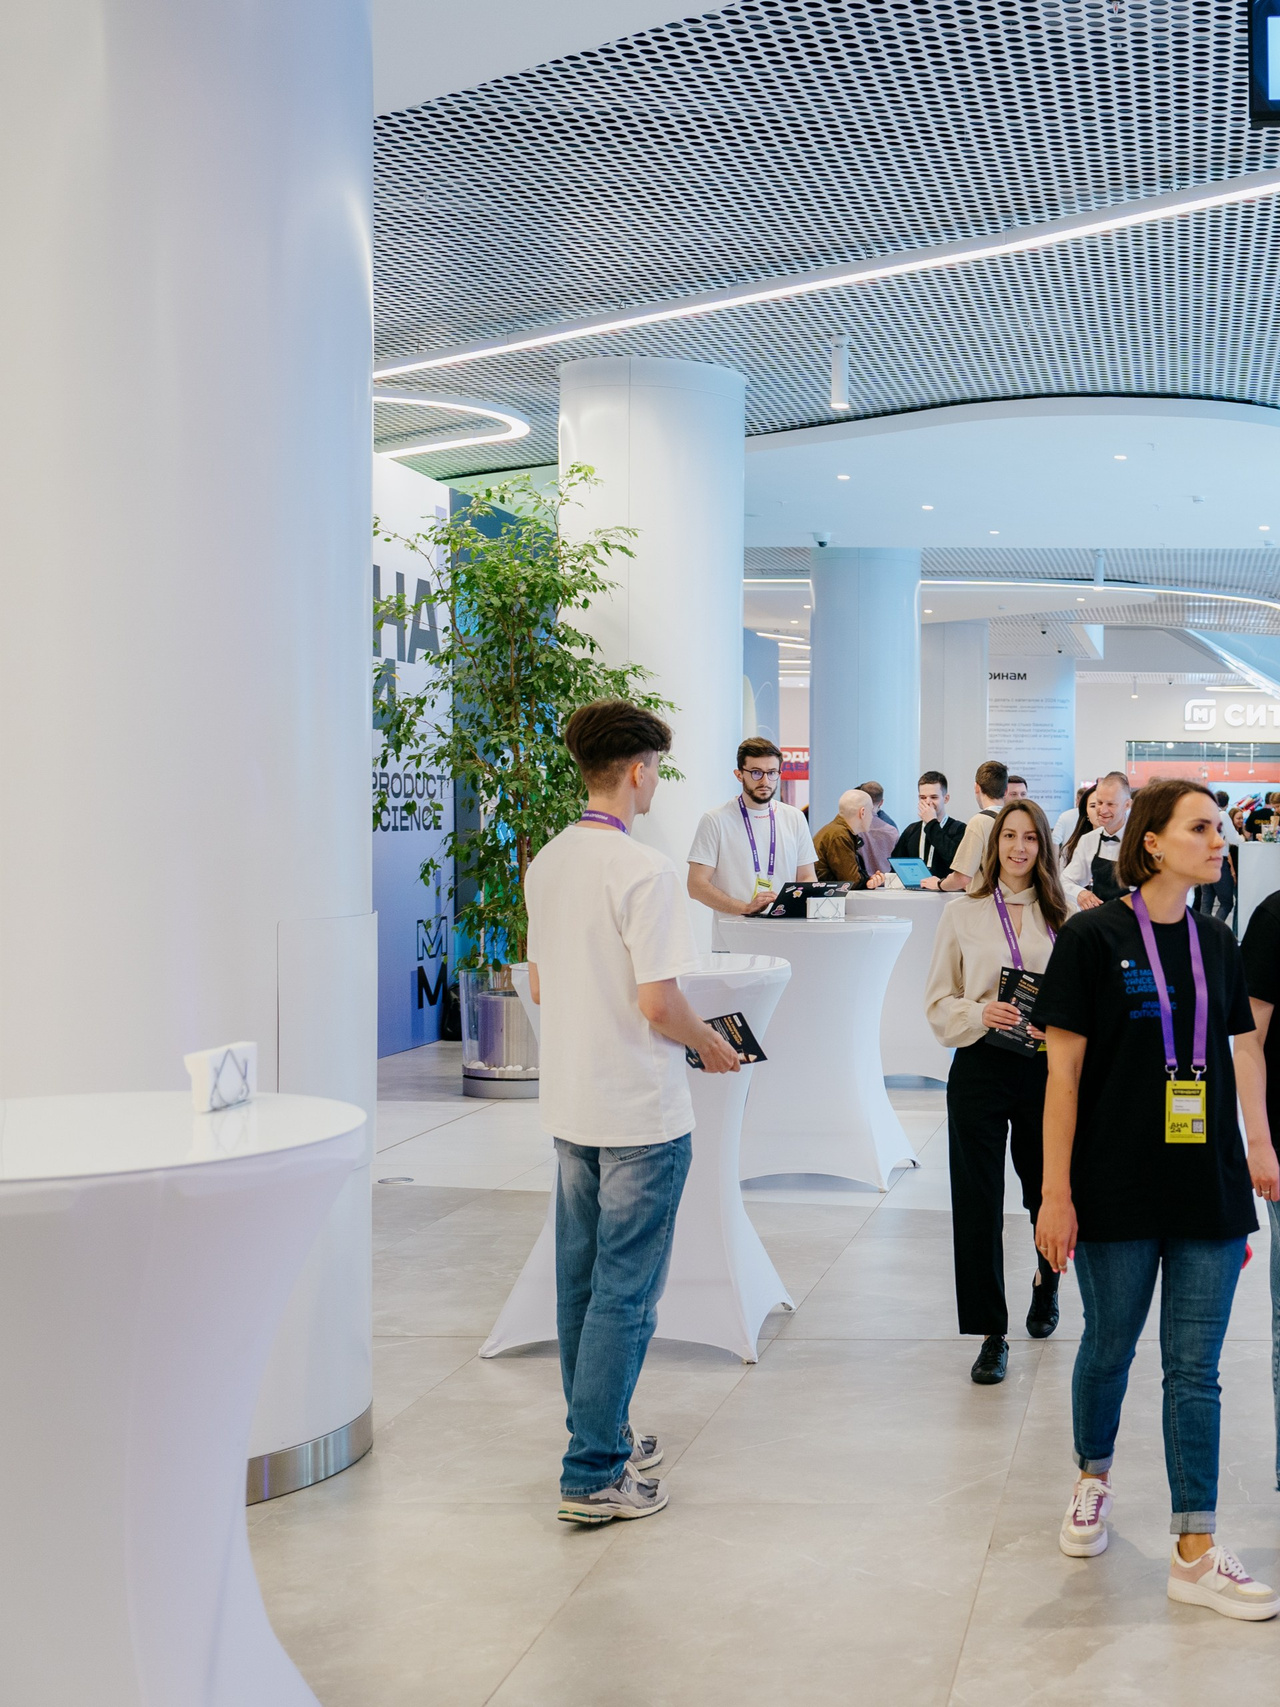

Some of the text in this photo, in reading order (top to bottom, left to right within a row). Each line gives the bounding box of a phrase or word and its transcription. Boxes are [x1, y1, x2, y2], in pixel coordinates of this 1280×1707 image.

[373, 806, 442, 832] CIENCE
[417, 916, 448, 961] M
[417, 960, 448, 1010] M
[1124, 977, 1155, 986] YANDE
[1169, 1121, 1189, 1129] AHA
